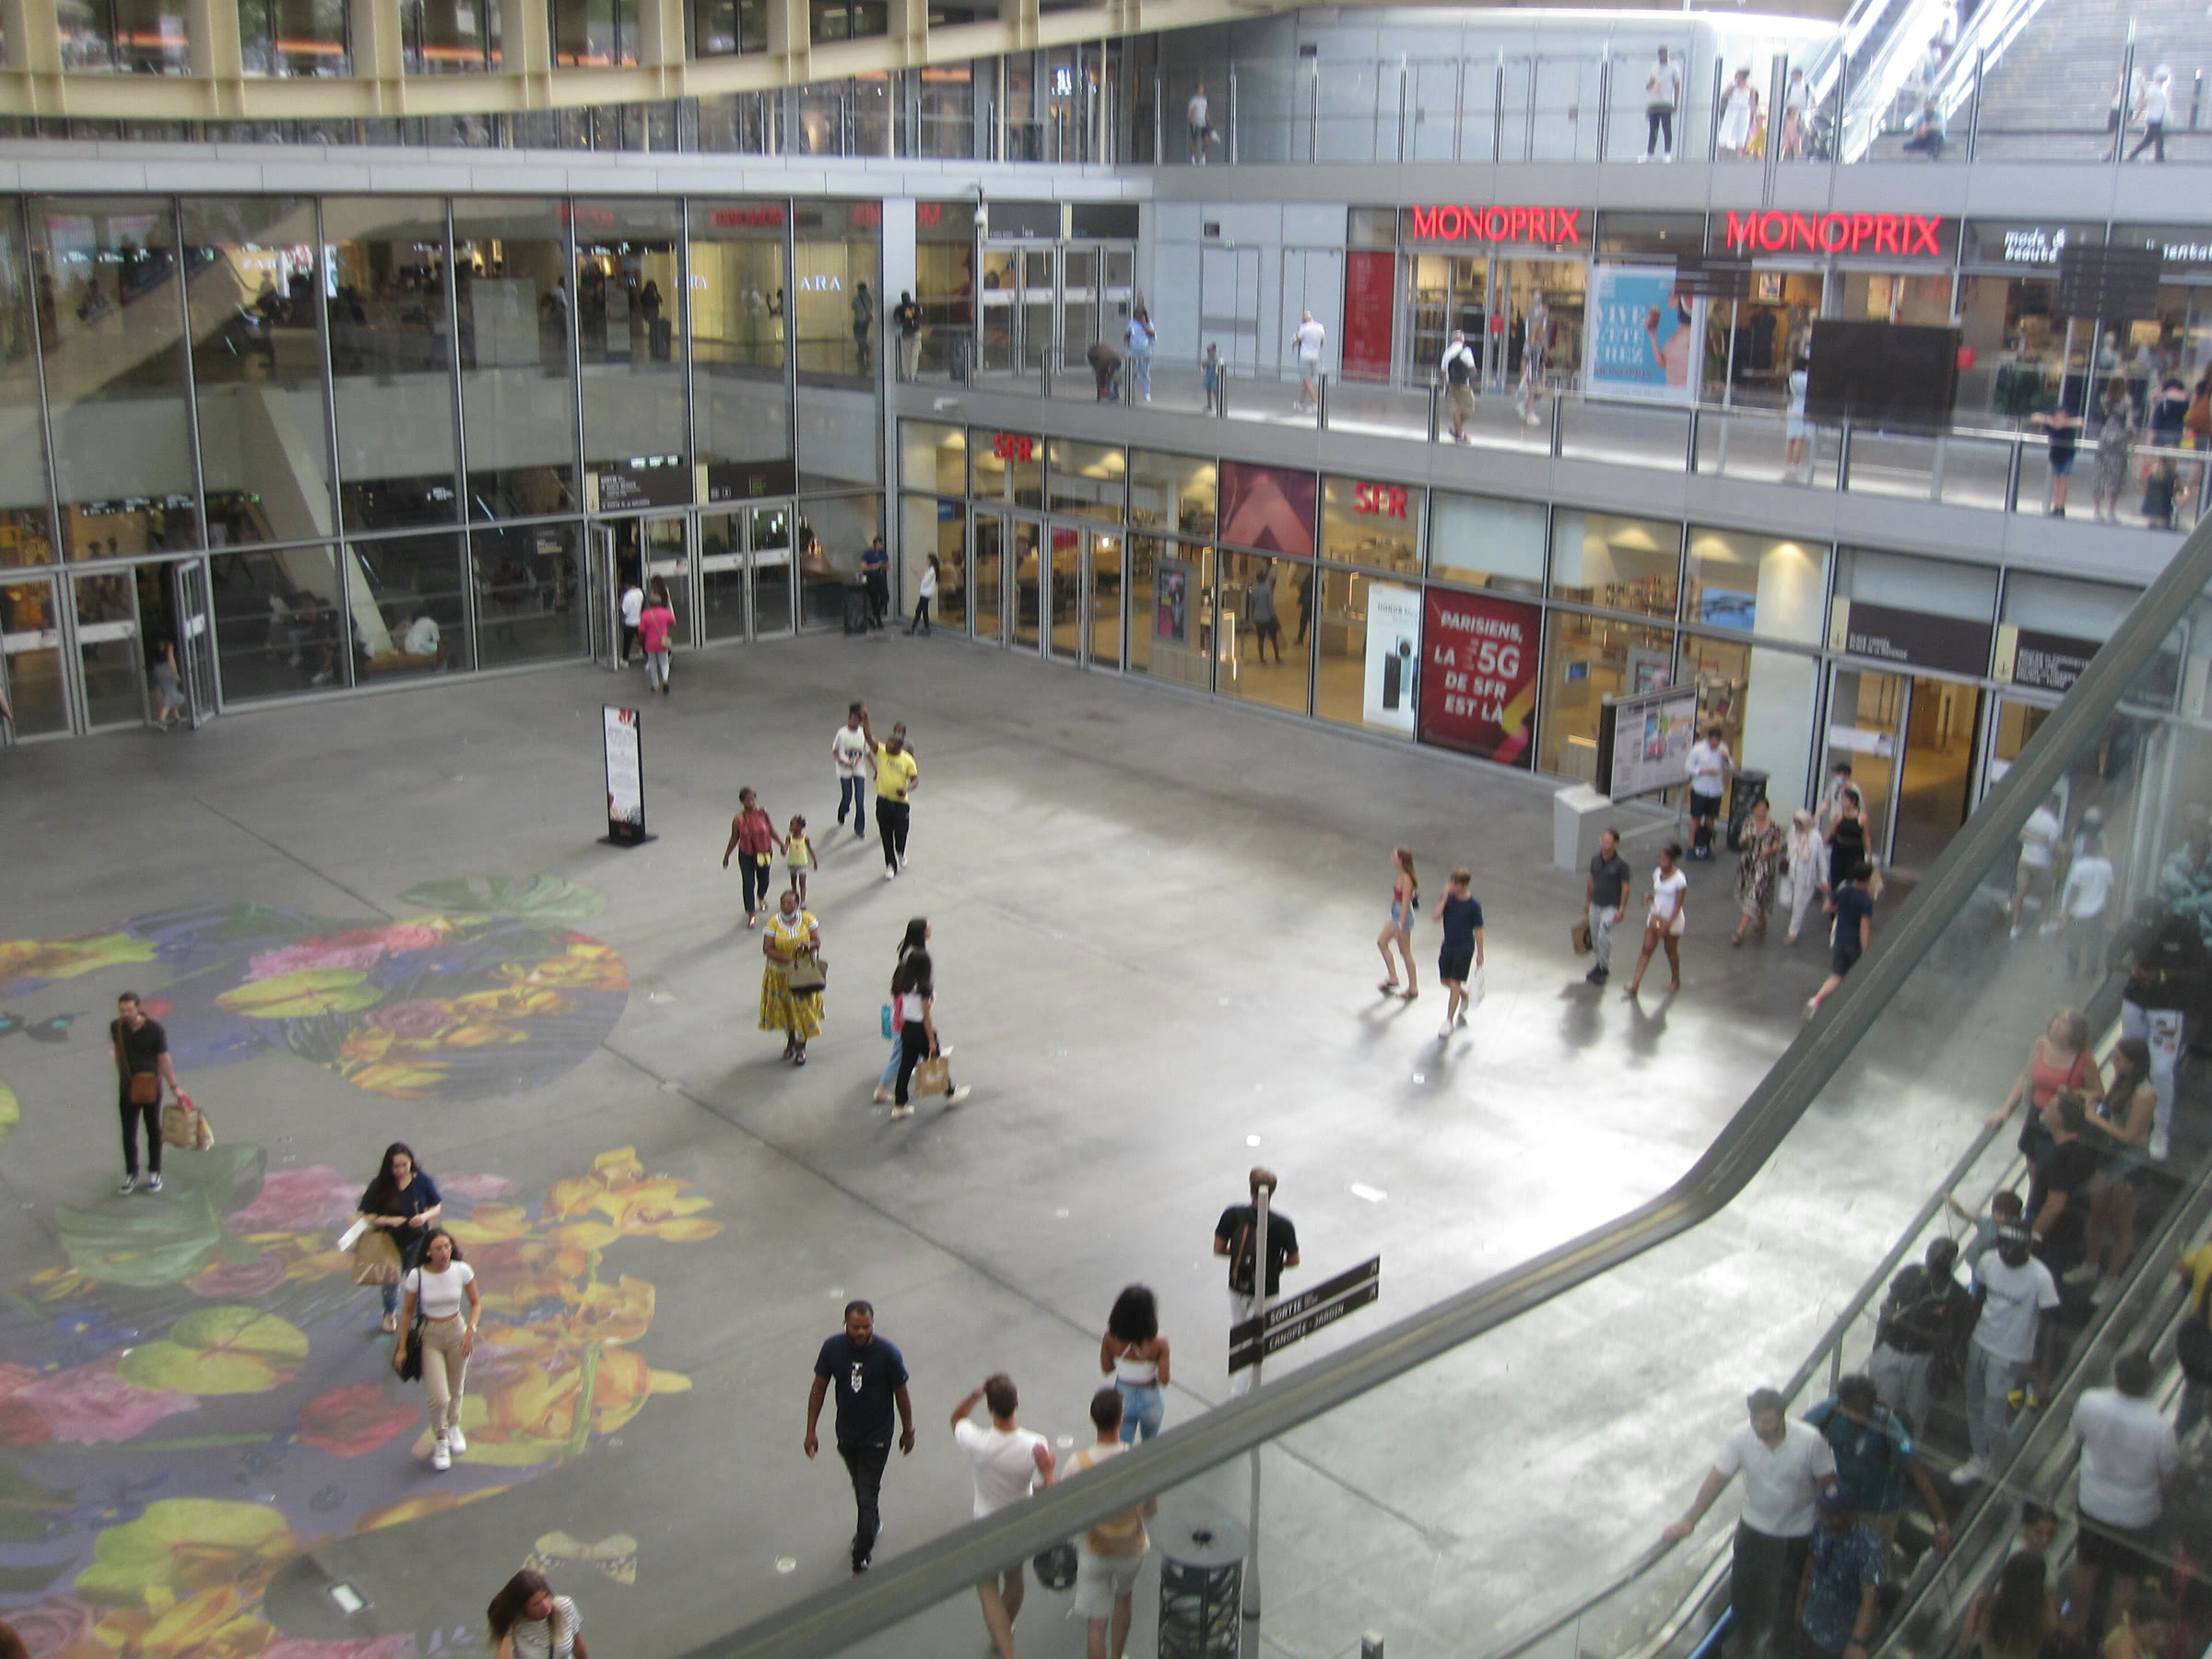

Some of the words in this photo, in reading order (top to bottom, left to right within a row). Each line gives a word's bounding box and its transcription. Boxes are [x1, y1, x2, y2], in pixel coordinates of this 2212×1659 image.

[1413, 206, 1579, 243] MONOPRIX
[1726, 210, 1942, 255] MONOPRIX
[994, 433, 1033, 465] SFR
[1355, 482, 1406, 519] SFR
[1441, 609, 1524, 644] PARISIENS,
[1433, 644, 1455, 667] LA
[1477, 640, 1521, 679] 5G
[1444, 670, 1468, 693] DE
[1472, 675, 1507, 702] SFR
[1444, 692, 1478, 717] EST
[1270, 1297, 1303, 1327] SORTIE
